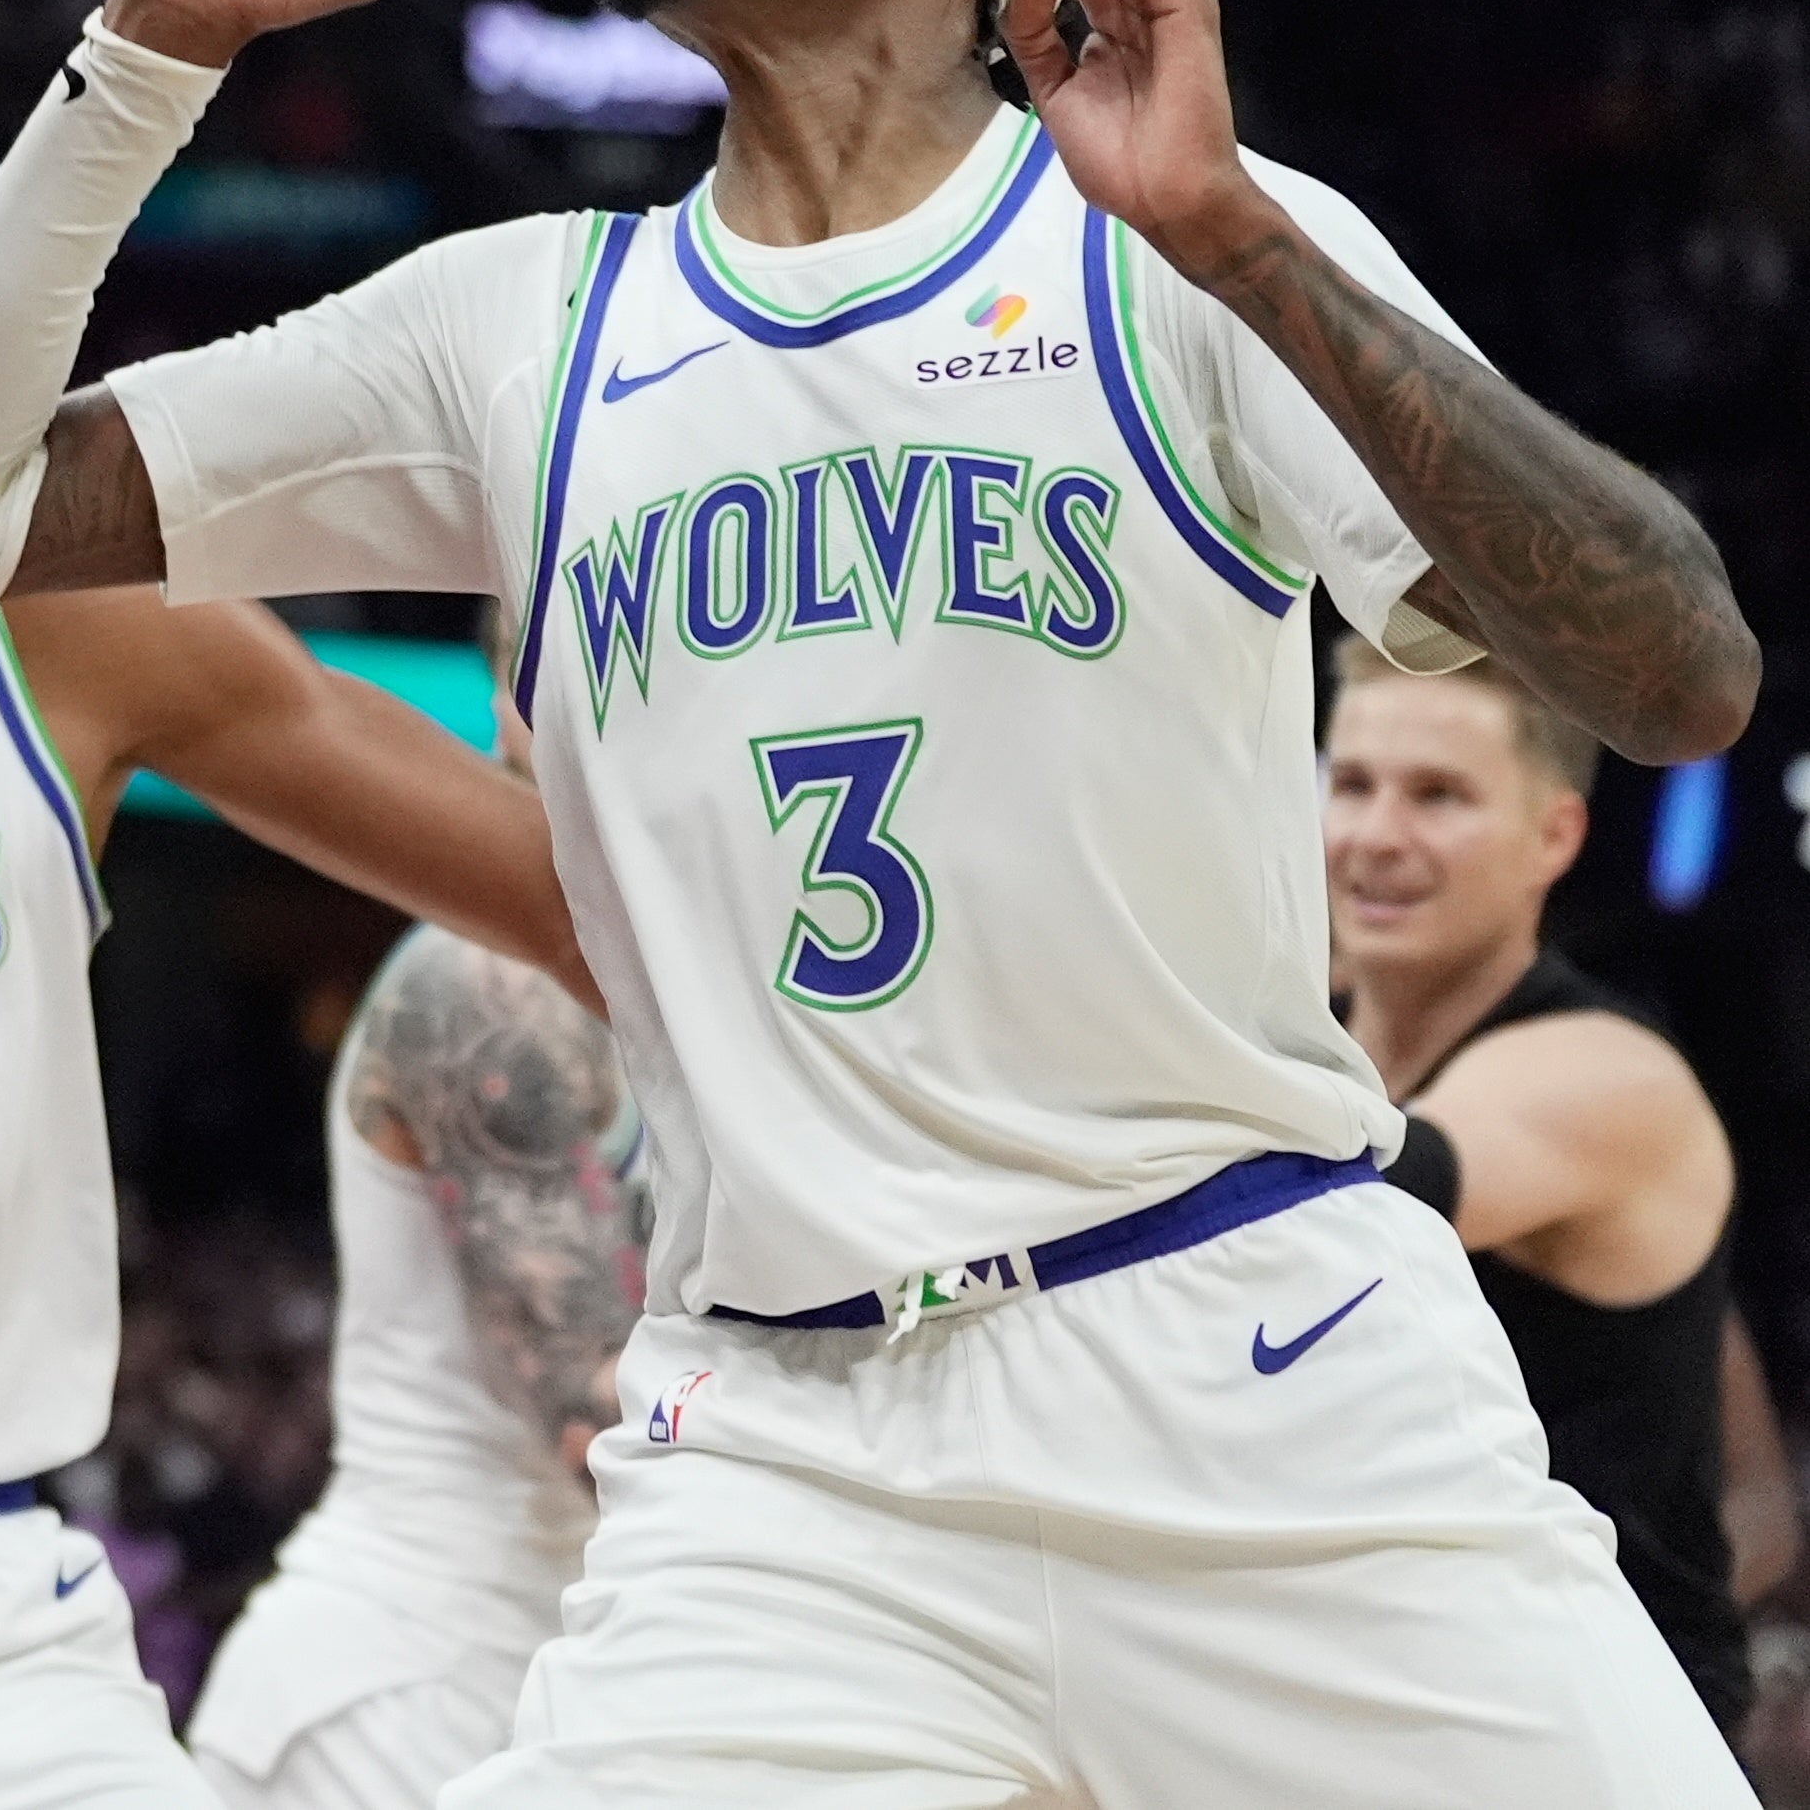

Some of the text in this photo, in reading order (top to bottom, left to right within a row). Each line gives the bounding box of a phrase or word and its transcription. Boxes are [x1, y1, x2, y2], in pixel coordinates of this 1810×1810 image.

[916, 335, 1079, 383] sezzle
[562, 444, 1125, 742] WOLVES
[749, 716, 934, 1013] 3
